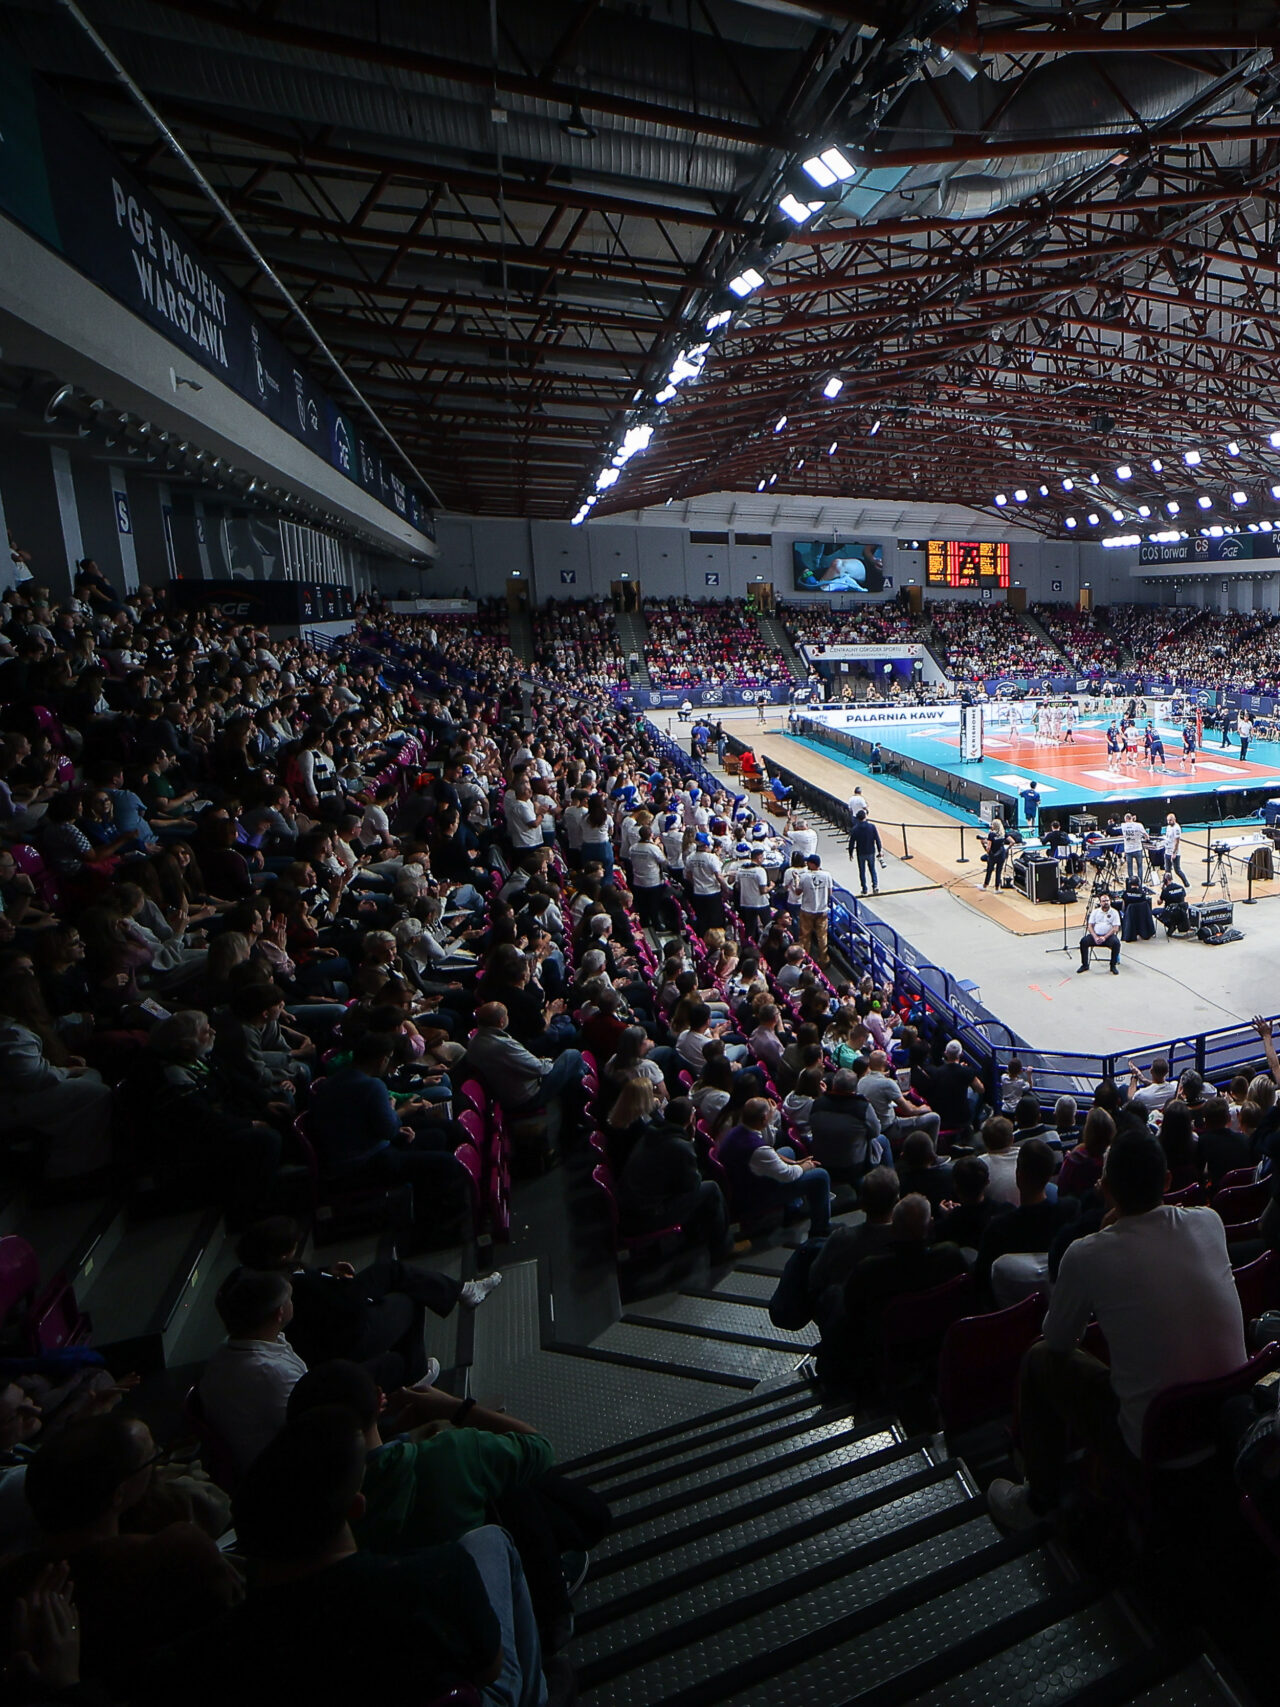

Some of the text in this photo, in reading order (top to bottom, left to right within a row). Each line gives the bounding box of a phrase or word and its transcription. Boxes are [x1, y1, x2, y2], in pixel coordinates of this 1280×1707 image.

[112, 177, 226, 326] PGE PROJEKT
[132, 249, 228, 368] WARSZAWA
[118, 500, 130, 528] S
[1142, 546, 1188, 560] COS Torwar
[1221, 546, 1239, 557] PGE
[562, 571, 575, 583] Y
[707, 575, 717, 584] Z
[883, 577, 892, 587] A
[1053, 581, 1061, 590] C
[1222, 583, 1228, 591] E
[983, 589, 991, 598] B
[846, 711, 945, 722] PALARNIA KAWY
